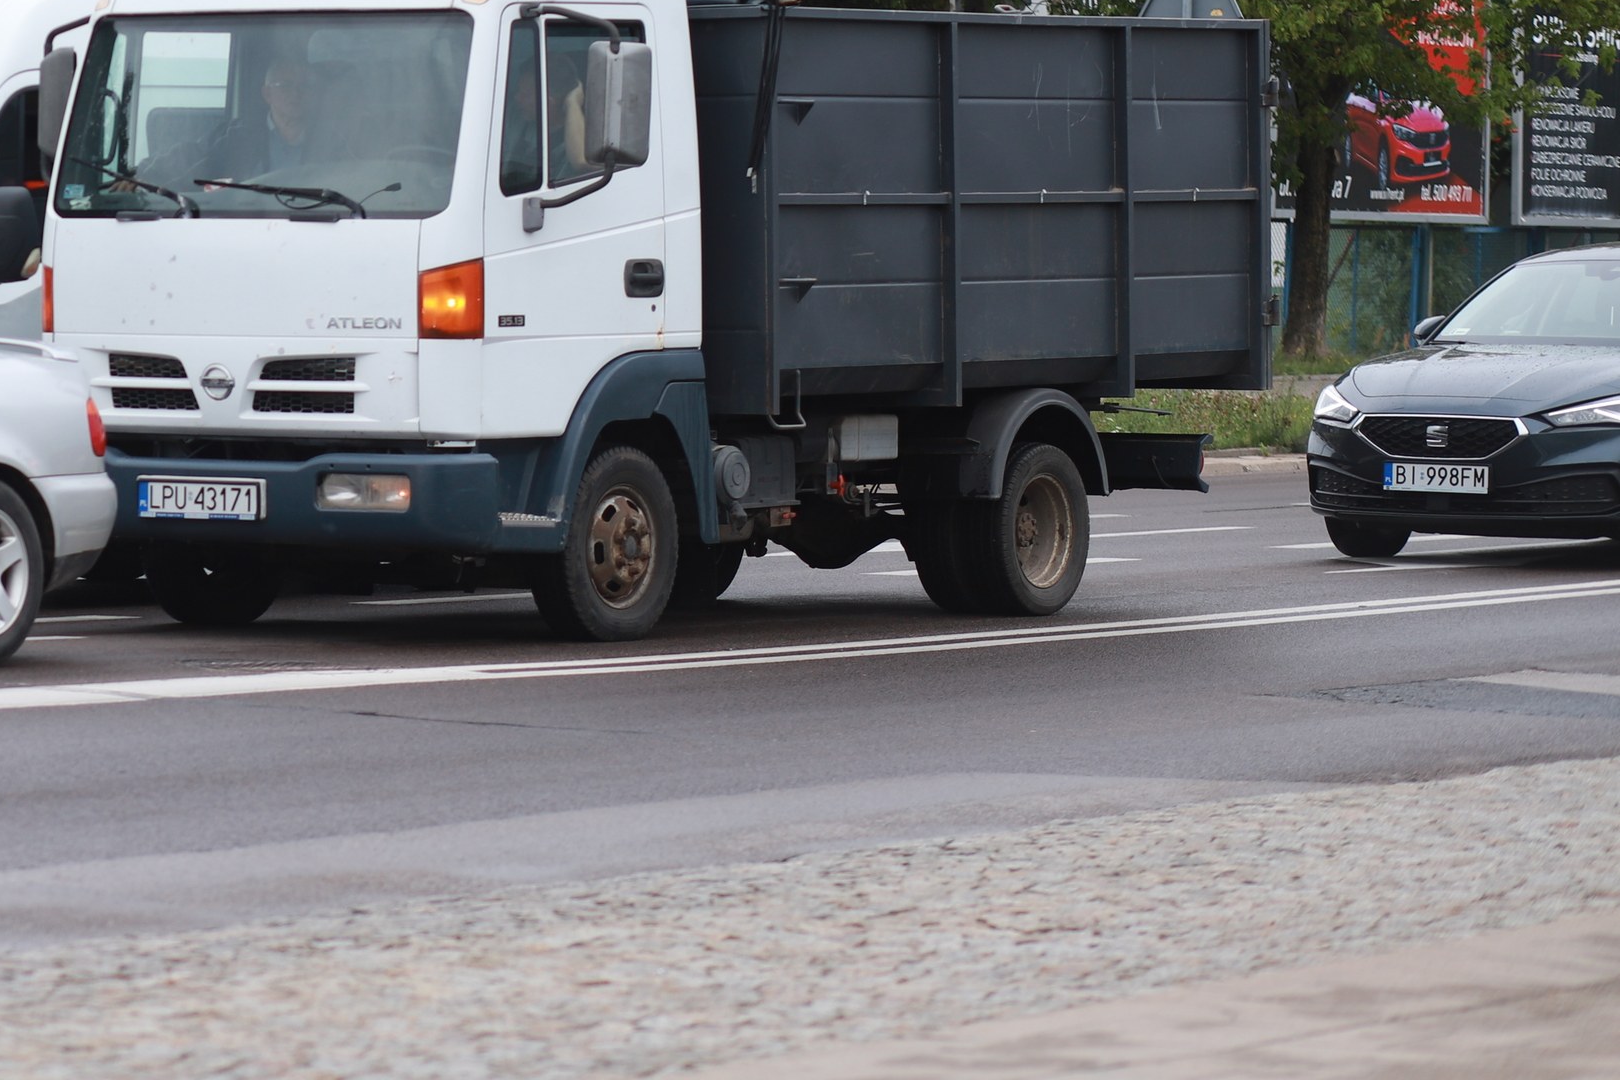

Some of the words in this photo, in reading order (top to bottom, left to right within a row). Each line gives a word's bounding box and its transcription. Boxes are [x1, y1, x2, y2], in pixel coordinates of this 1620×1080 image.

[326, 317, 402, 330] ATLEON
[149, 484, 187, 510] LPU
[193, 486, 252, 513] 43171
